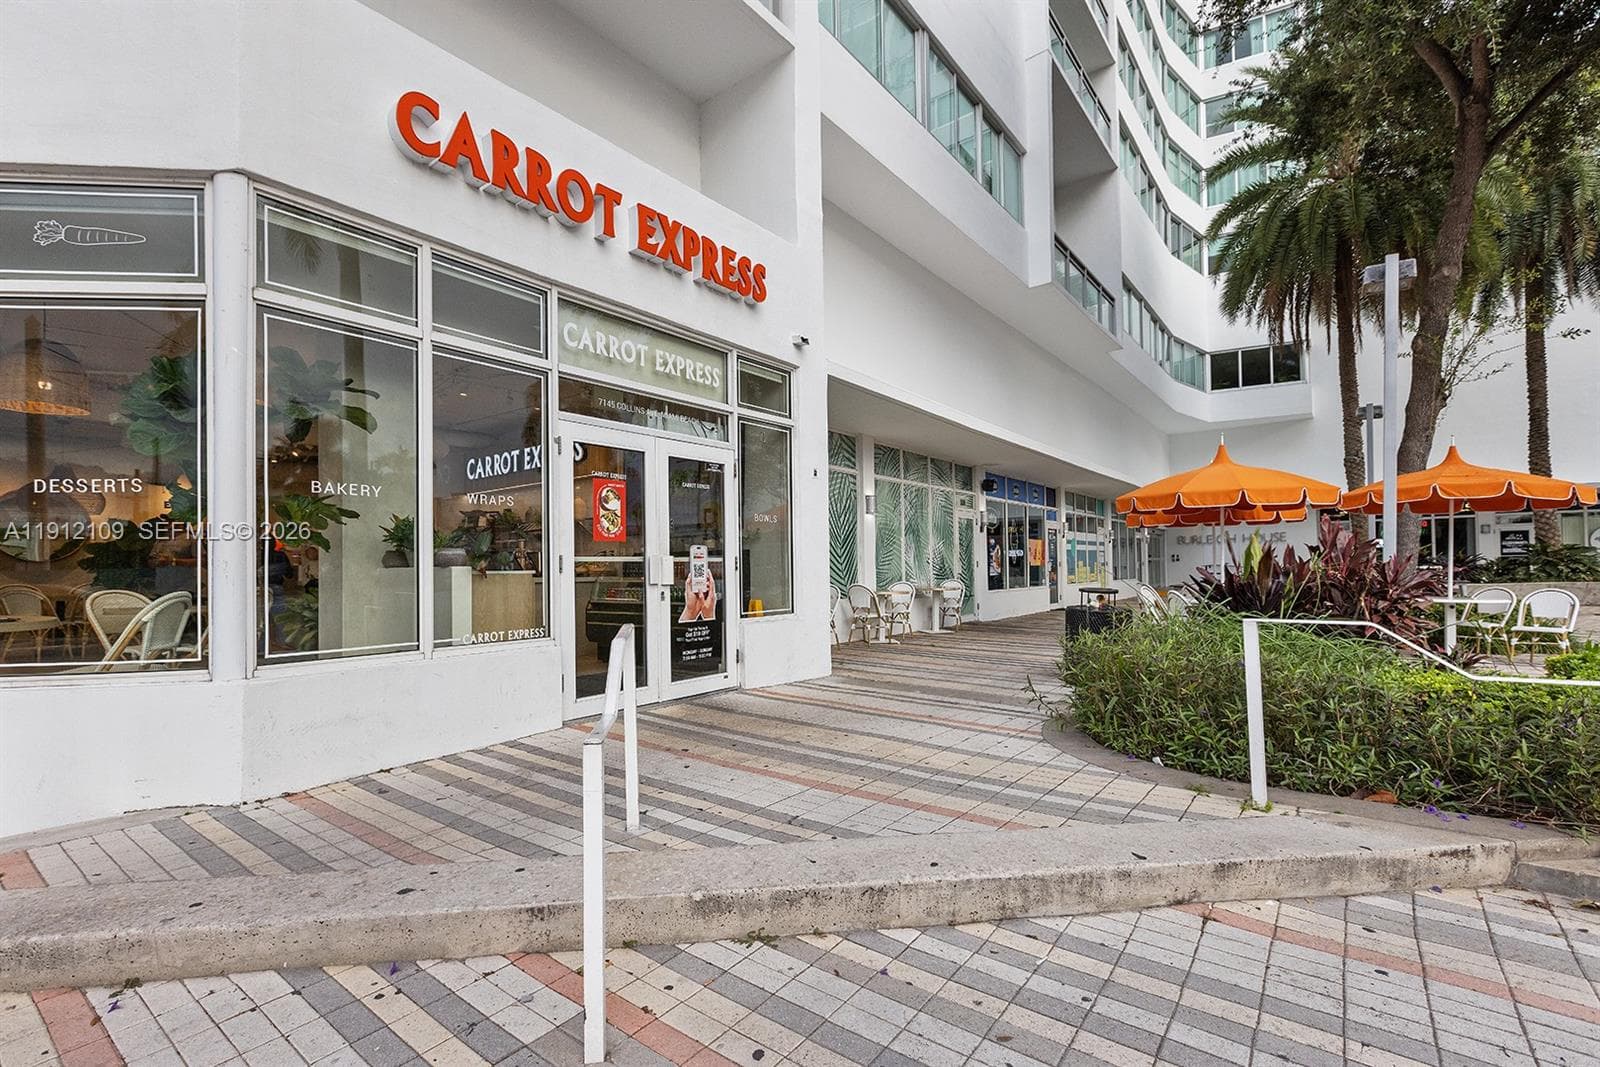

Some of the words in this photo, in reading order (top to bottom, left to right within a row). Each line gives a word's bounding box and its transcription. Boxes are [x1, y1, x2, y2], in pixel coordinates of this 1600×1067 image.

[395, 90, 623, 239] CARROT
[636, 202, 767, 304] EXPRESS
[563, 321, 649, 368] CARROT
[655, 348, 722, 389] EXPRESS
[598, 397, 616, 410] 7145
[616, 402, 646, 416] COLLINS
[466, 449, 520, 480] CARROT
[33, 478, 144, 494] DESSERTS
[311, 480, 382, 498] BAKERY
[466, 493, 515, 507] WRAPS
[753, 513, 778, 524] BOWLS
[462, 631, 505, 645] CARROT
[508, 627, 545, 641] EXPRESS
